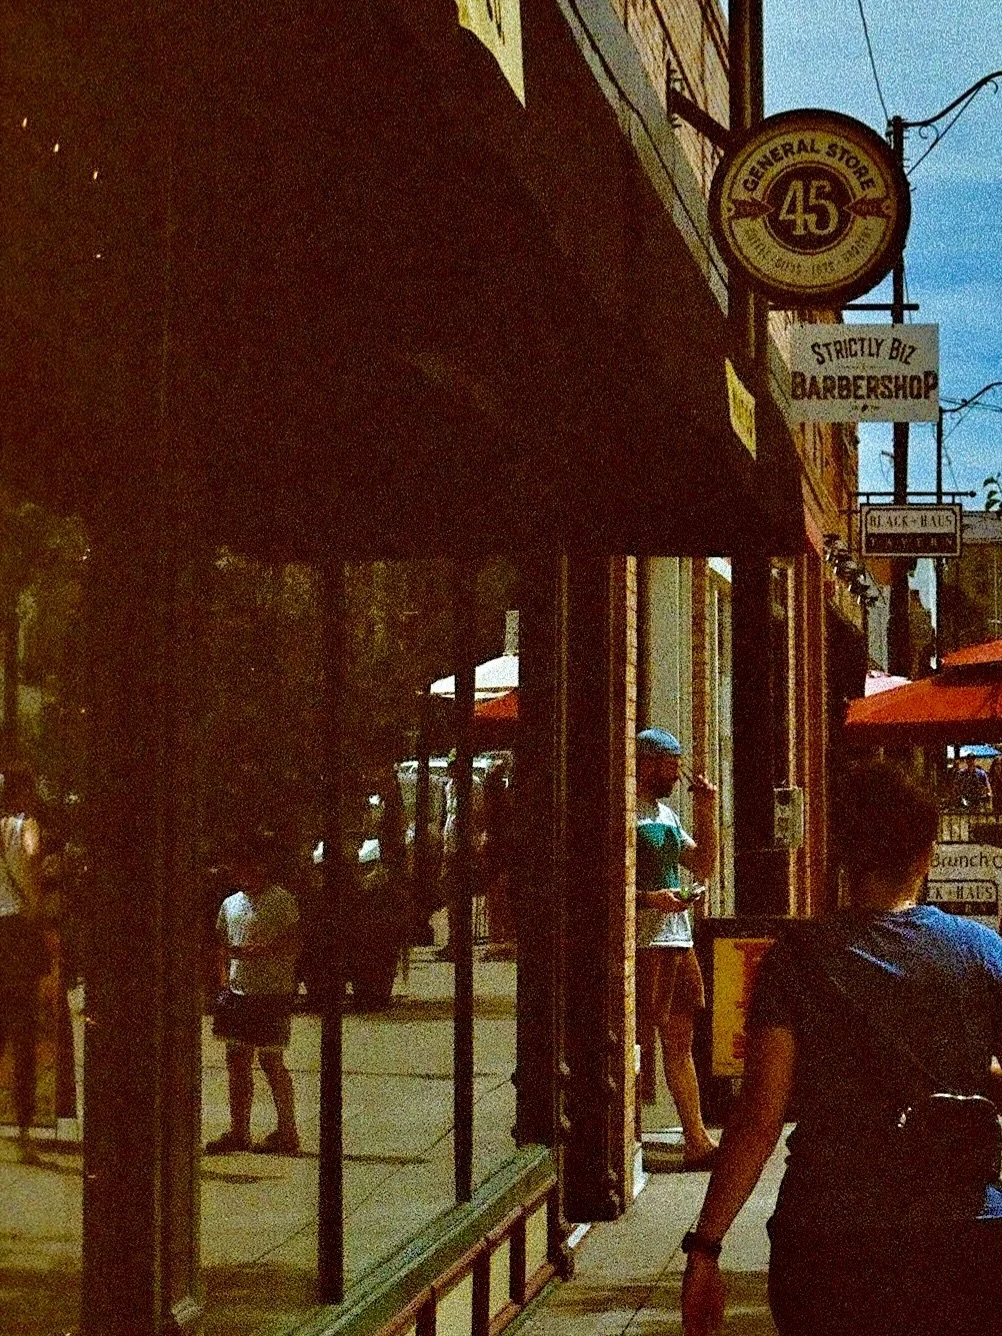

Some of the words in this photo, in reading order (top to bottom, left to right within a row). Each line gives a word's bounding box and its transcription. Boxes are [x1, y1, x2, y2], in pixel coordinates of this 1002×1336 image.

[743, 138, 820, 192] GENERAL
[825, 142, 876, 191] STORE
[778, 179, 840, 236] 45
[811, 337, 885, 365] STRICTLY
[889, 337, 917, 365] BIZ
[791, 371, 938, 401] BARBERSHOP
[930, 852, 989, 868] Brunch
